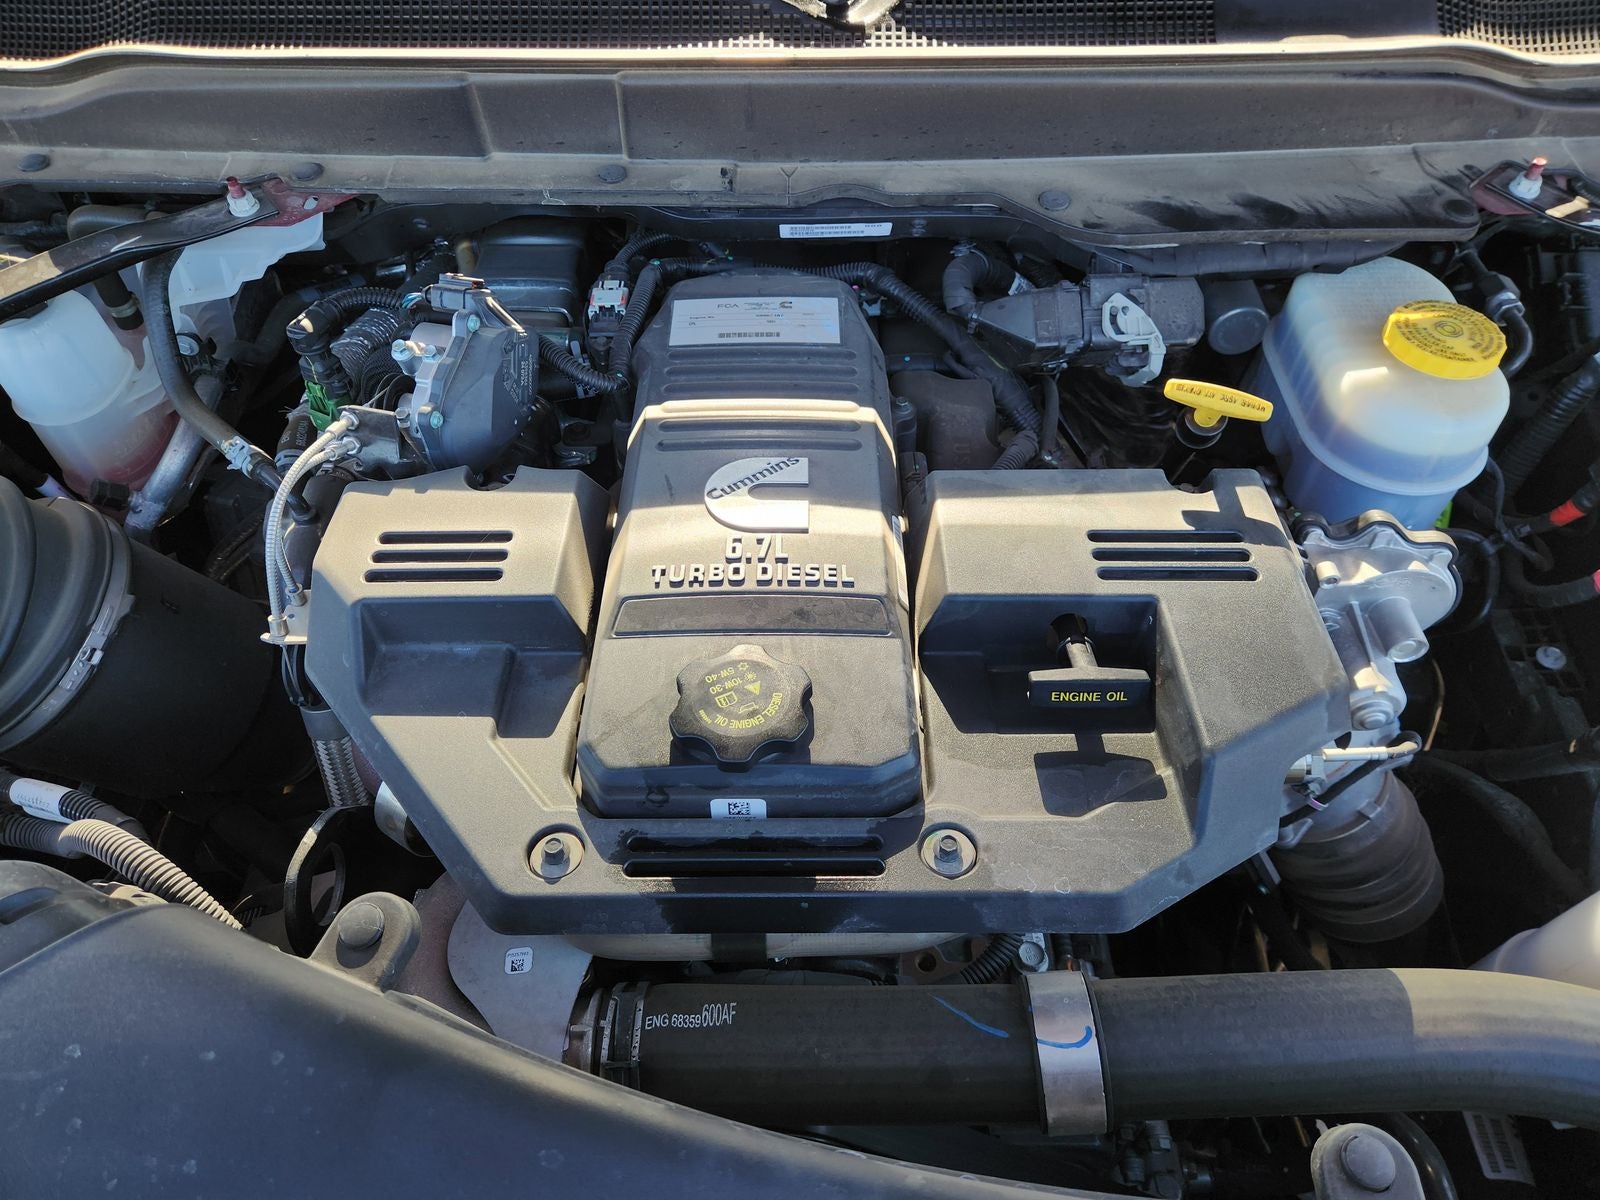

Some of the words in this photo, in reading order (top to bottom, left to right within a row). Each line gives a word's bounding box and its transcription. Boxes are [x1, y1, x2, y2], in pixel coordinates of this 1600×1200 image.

[706, 456, 800, 500] Cummins
[725, 535, 788, 562] 6.7L
[652, 563, 745, 588] TURBO
[756, 562, 855, 588] DIESEL
[705, 667, 735, 683] 5W-40
[709, 677, 743, 694] 10W-30
[762, 692, 783, 717] DIESEL
[1051, 691, 1101, 702] ENGINE
[1106, 691, 1128, 702] OIL
[714, 714, 729, 727] OIL
[729, 715, 765, 729] ENGINE
[645, 1013, 669, 1030] ENG
